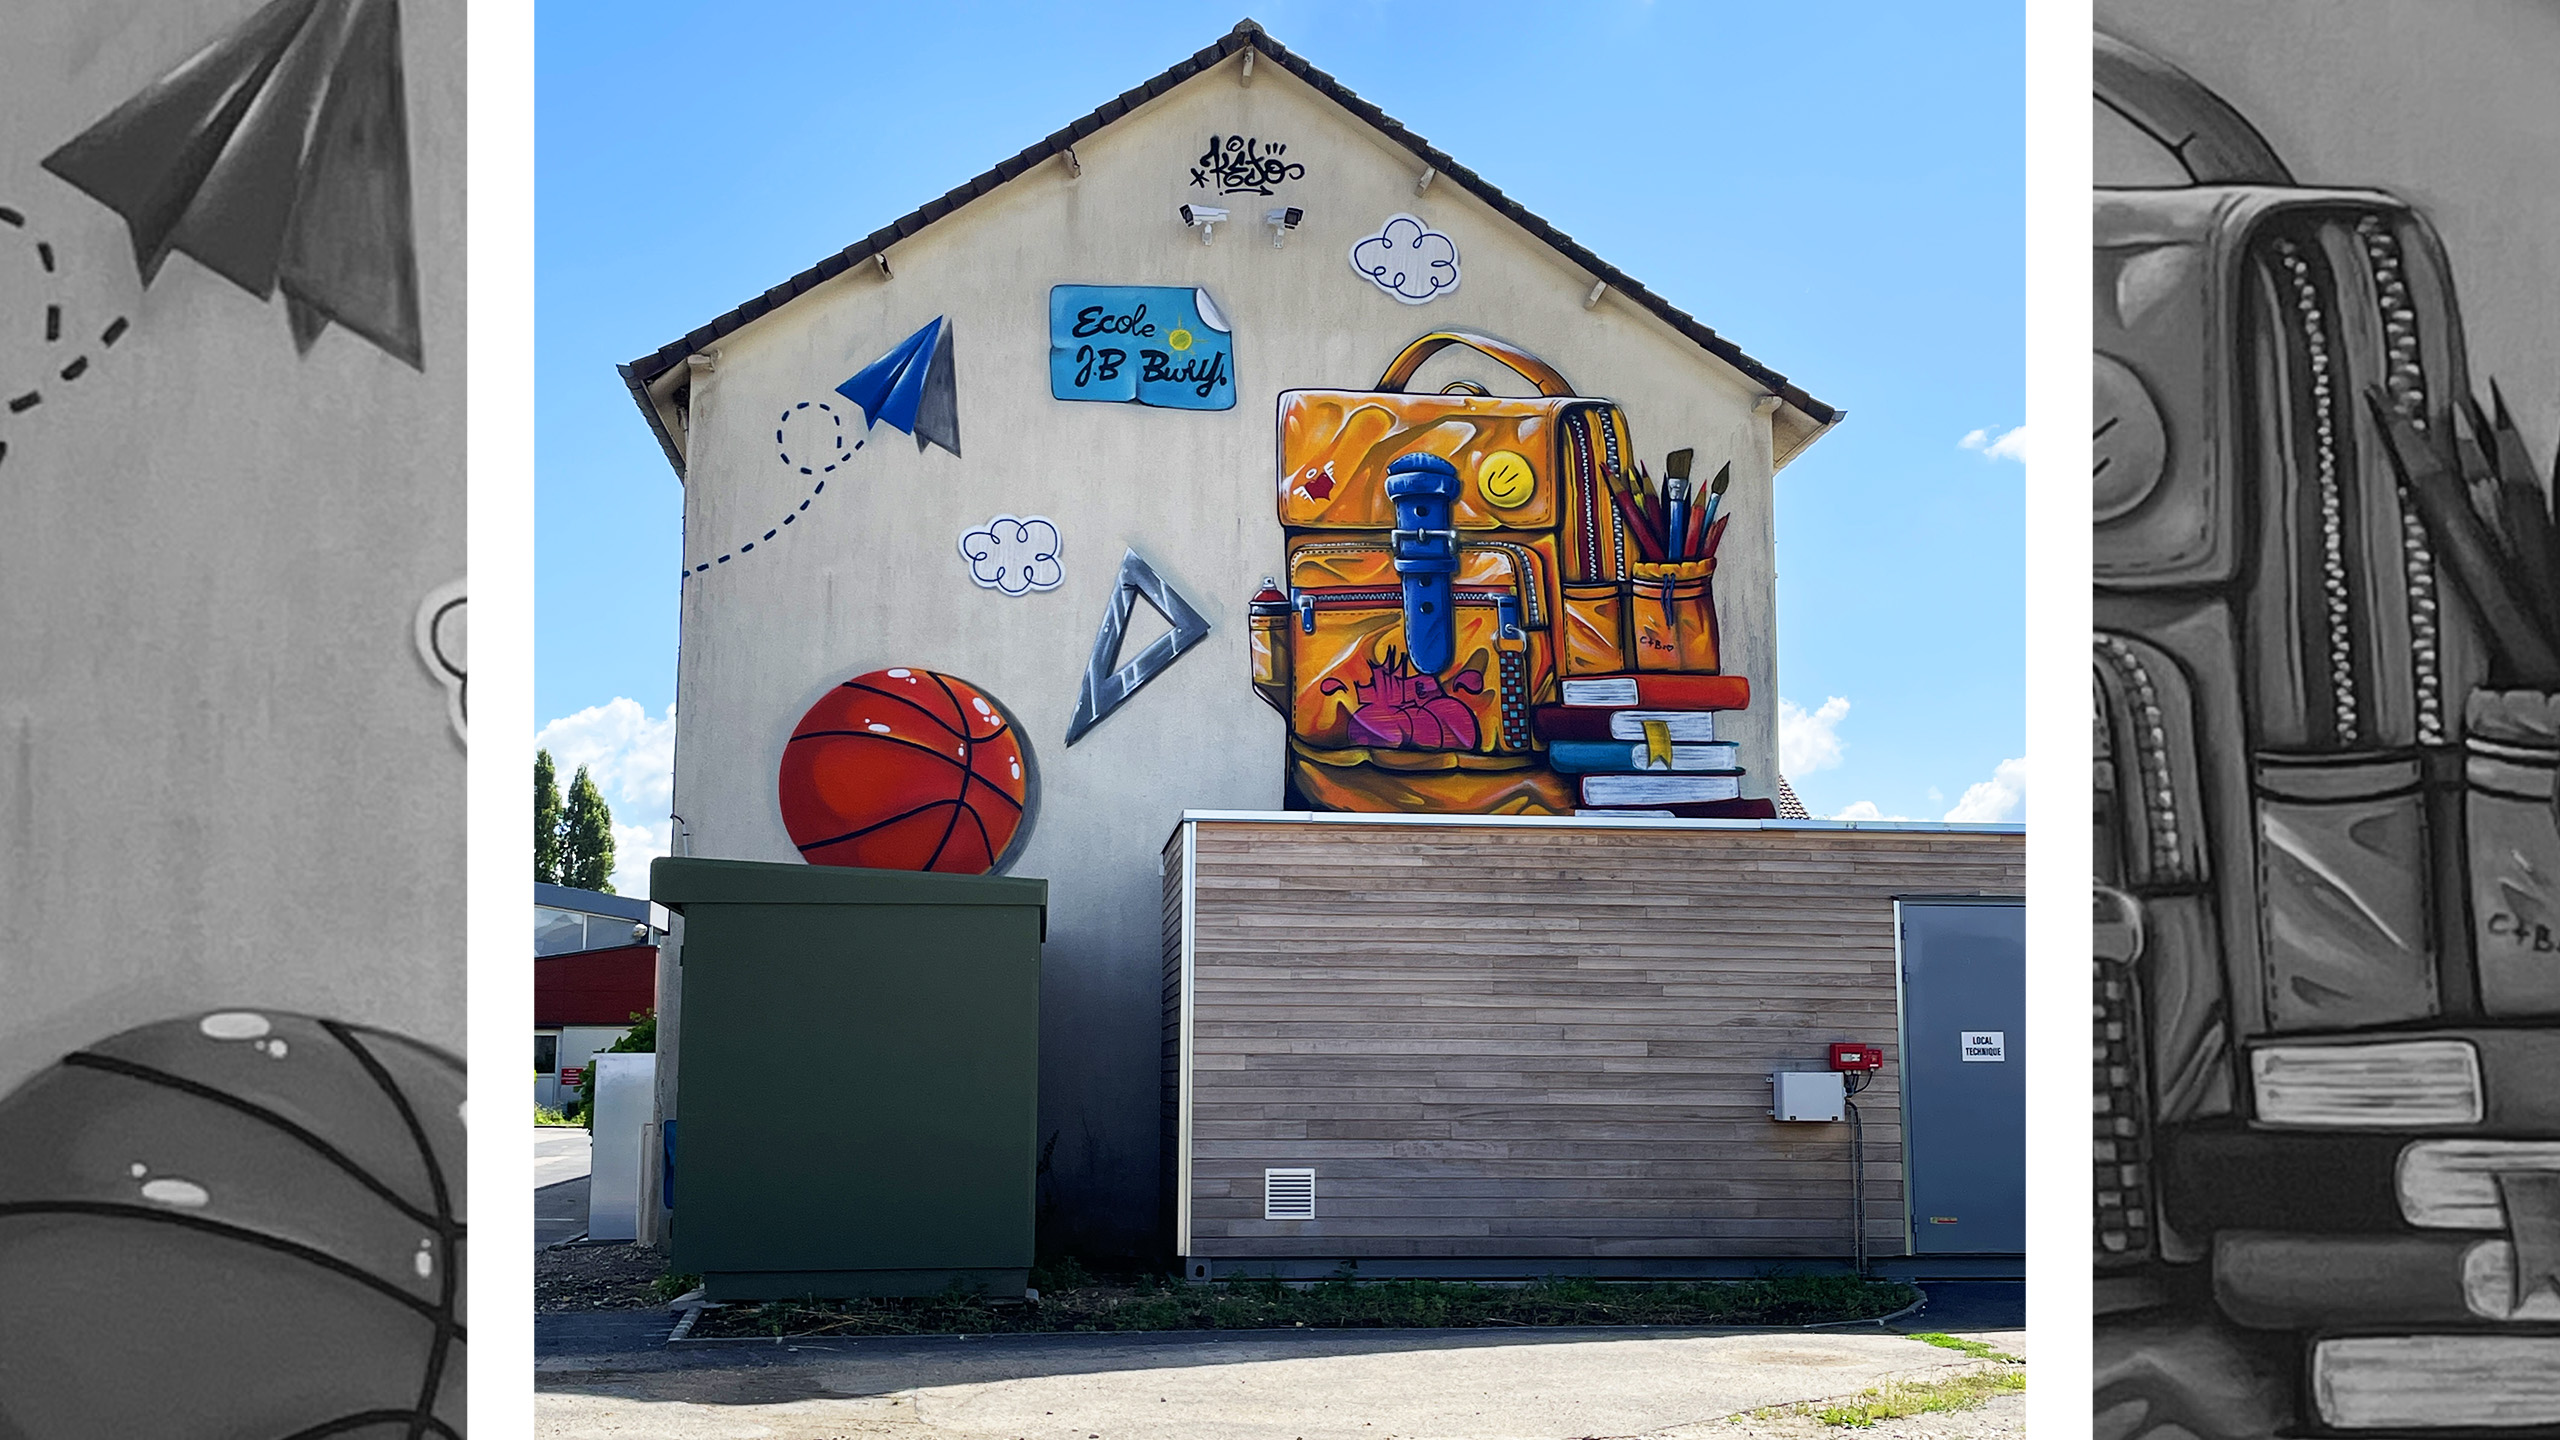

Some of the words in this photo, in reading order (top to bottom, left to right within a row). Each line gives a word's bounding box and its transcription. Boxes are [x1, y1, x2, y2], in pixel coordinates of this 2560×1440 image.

[1072, 303, 1155, 338] Ecole
[1972, 1036, 1993, 1045] LOCAL
[1965, 1047, 2002, 1056] TECHNIQUE
